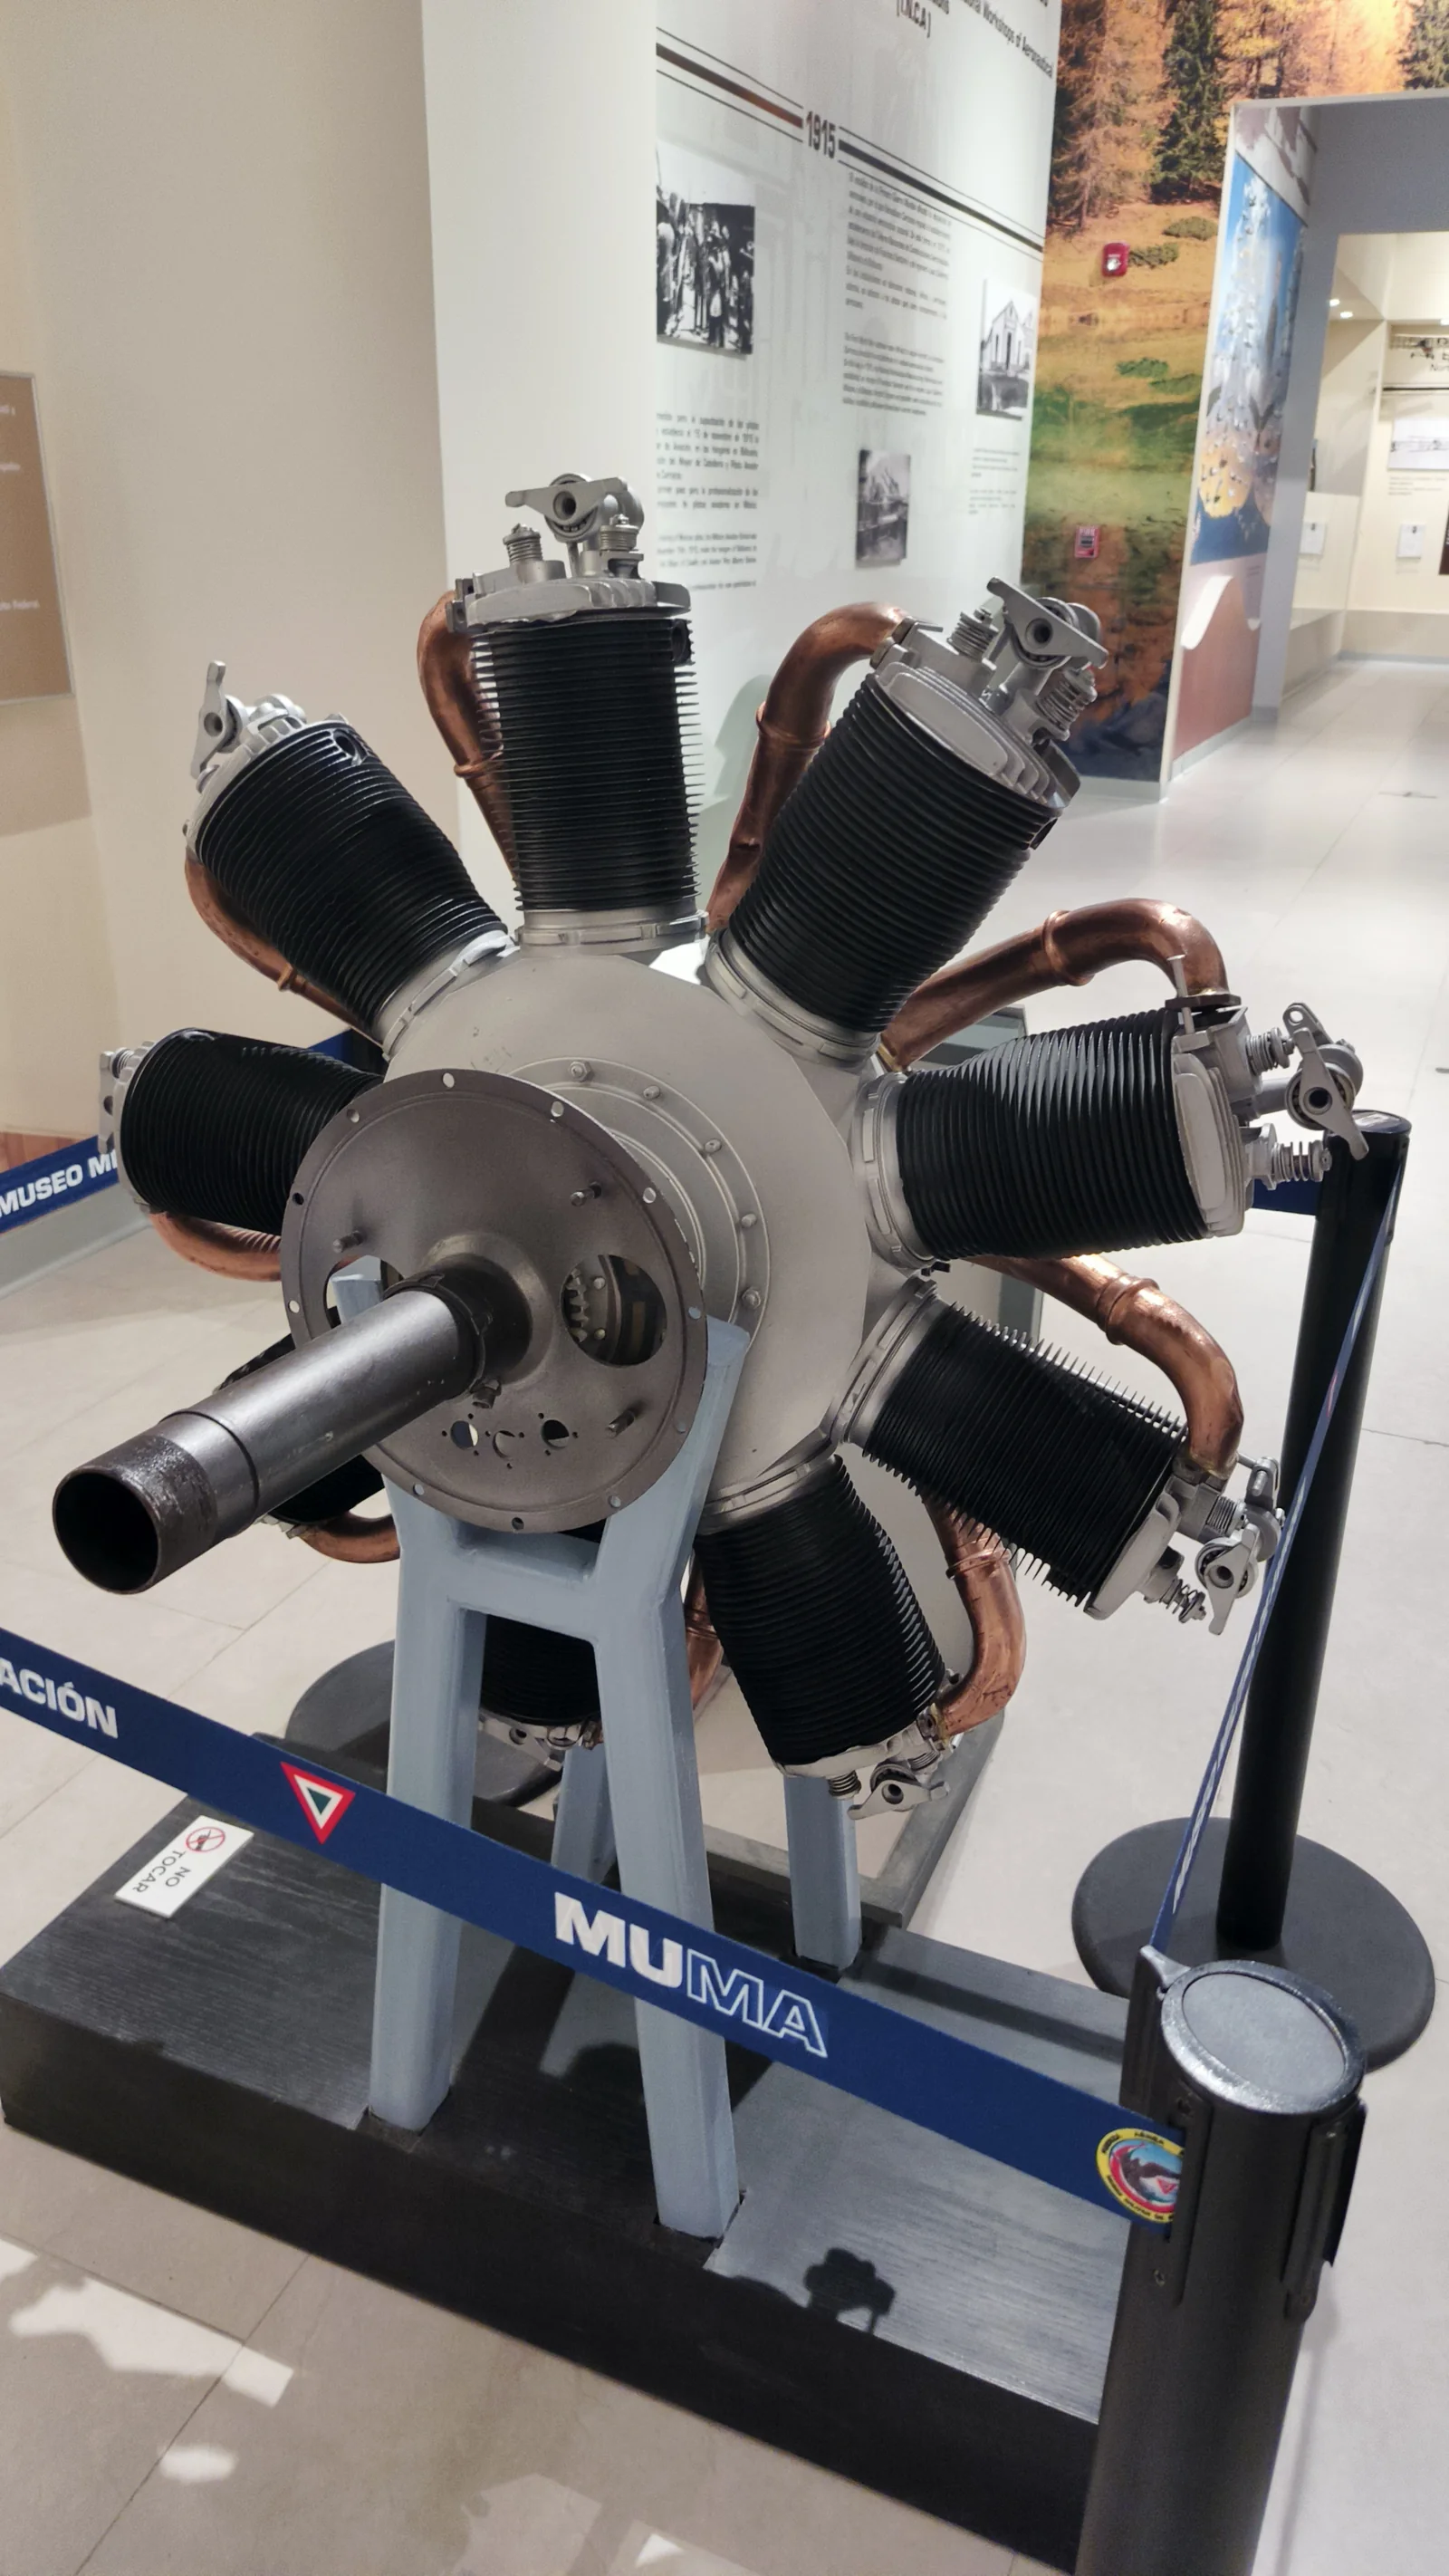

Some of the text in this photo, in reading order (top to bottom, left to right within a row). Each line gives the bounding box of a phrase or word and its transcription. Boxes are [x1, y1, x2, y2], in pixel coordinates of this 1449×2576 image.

[806, 111, 836, 159] 1915
[0, 1164, 83, 1218] MUSEO
[133, 1850, 187, 1893] TOCAR
[165, 1866, 191, 1887] NO
[554, 1891, 828, 2058] MUMA
